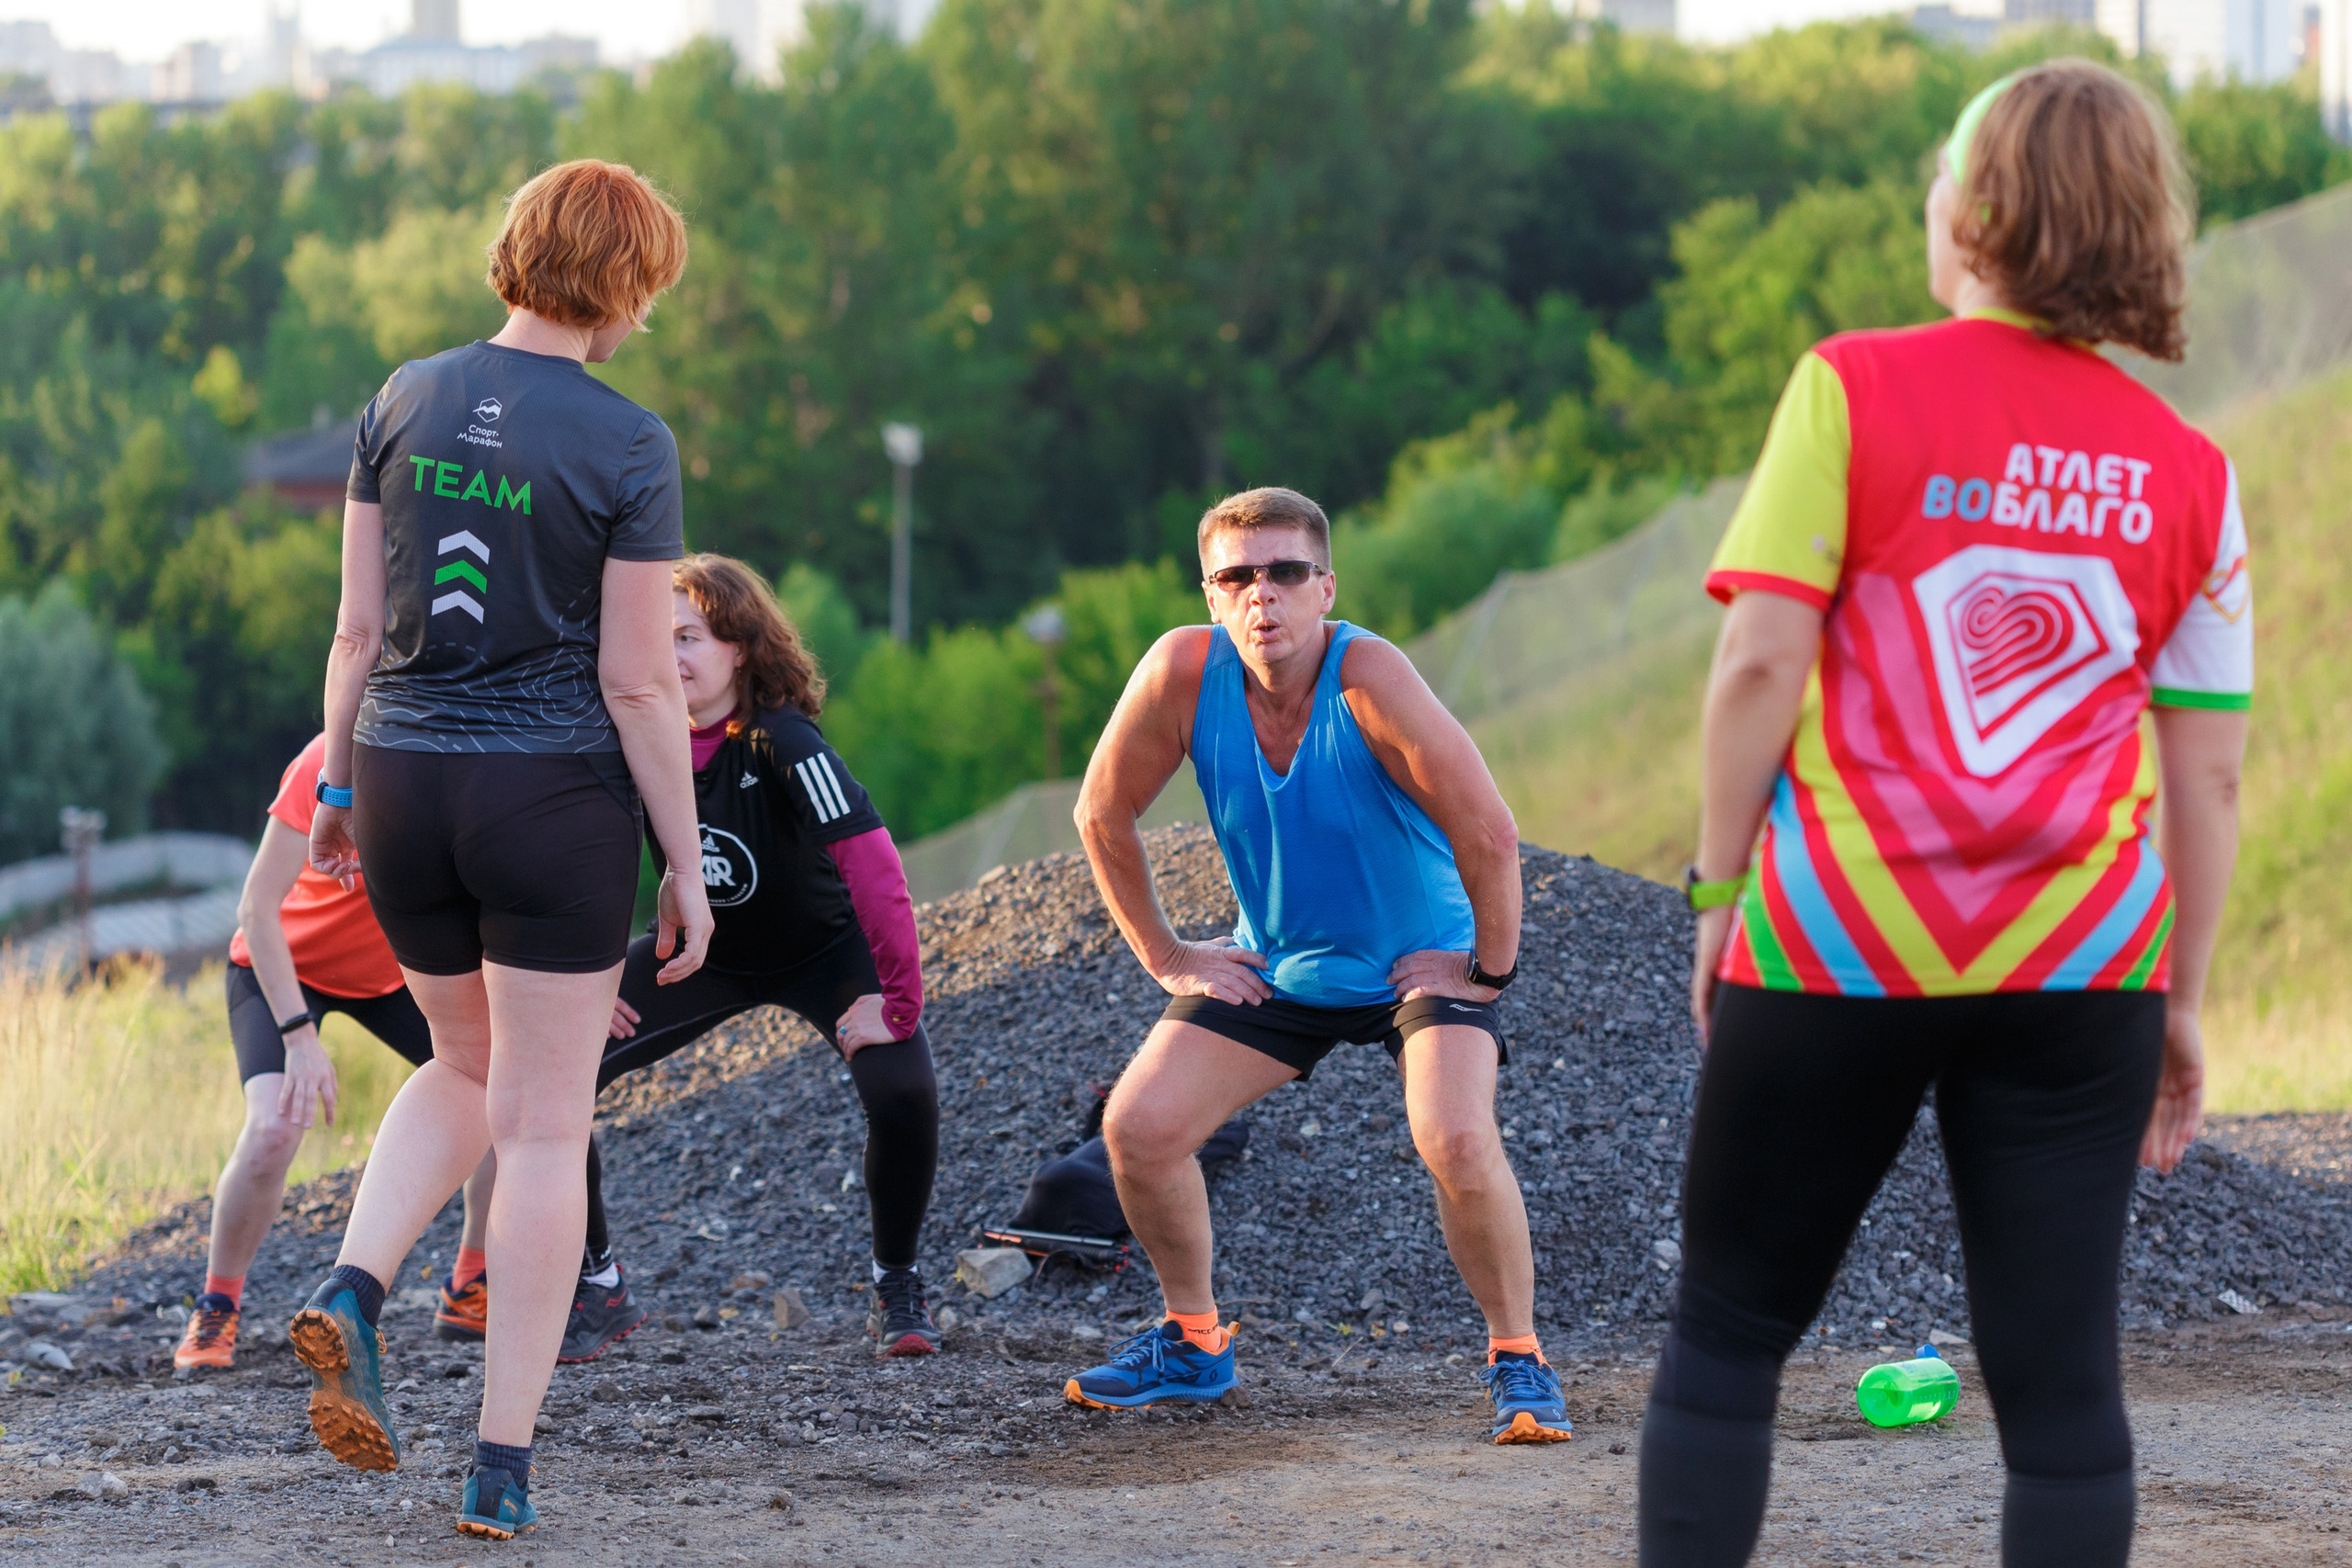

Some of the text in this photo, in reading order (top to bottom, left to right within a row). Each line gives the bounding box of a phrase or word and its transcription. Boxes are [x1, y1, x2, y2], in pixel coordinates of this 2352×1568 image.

[457, 433, 503, 448] Марафон
[409, 455, 531, 515] TEAM
[2004, 442, 2152, 499] АТЛЕТ
